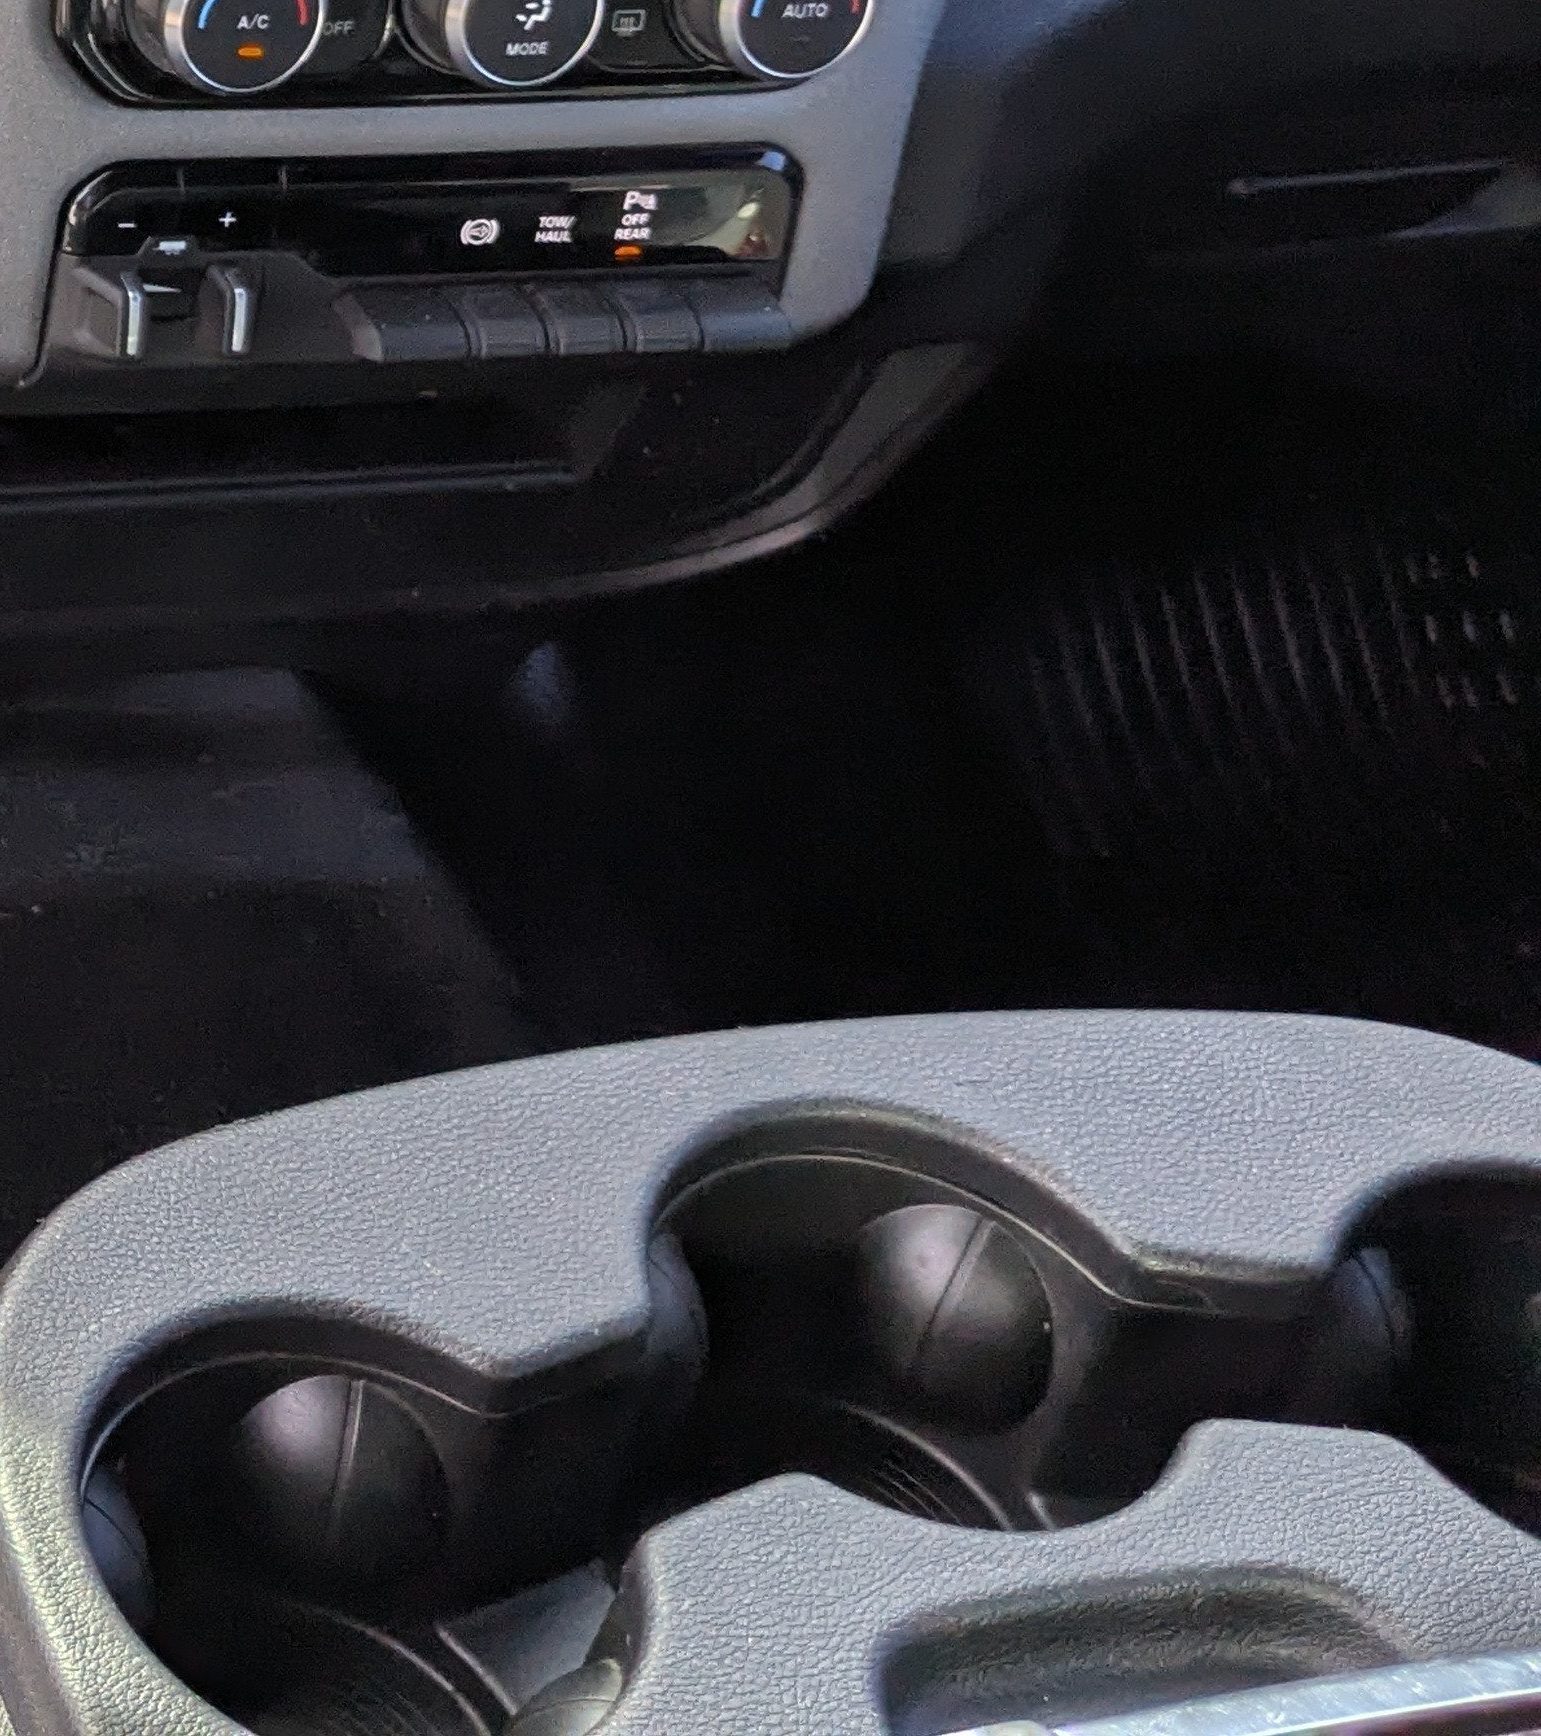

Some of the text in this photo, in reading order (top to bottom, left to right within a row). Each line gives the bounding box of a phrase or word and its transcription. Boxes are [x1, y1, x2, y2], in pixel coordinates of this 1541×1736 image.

[781, 2, 830, 19] AUTO
[236, 14, 269, 30] A/C
[322, 20, 355, 36] OFF
[505, 41, 549, 56] MODE
[620, 213, 650, 227] OFF
[535, 230, 572, 243] HAUL
[614, 227, 653, 241] REAR
